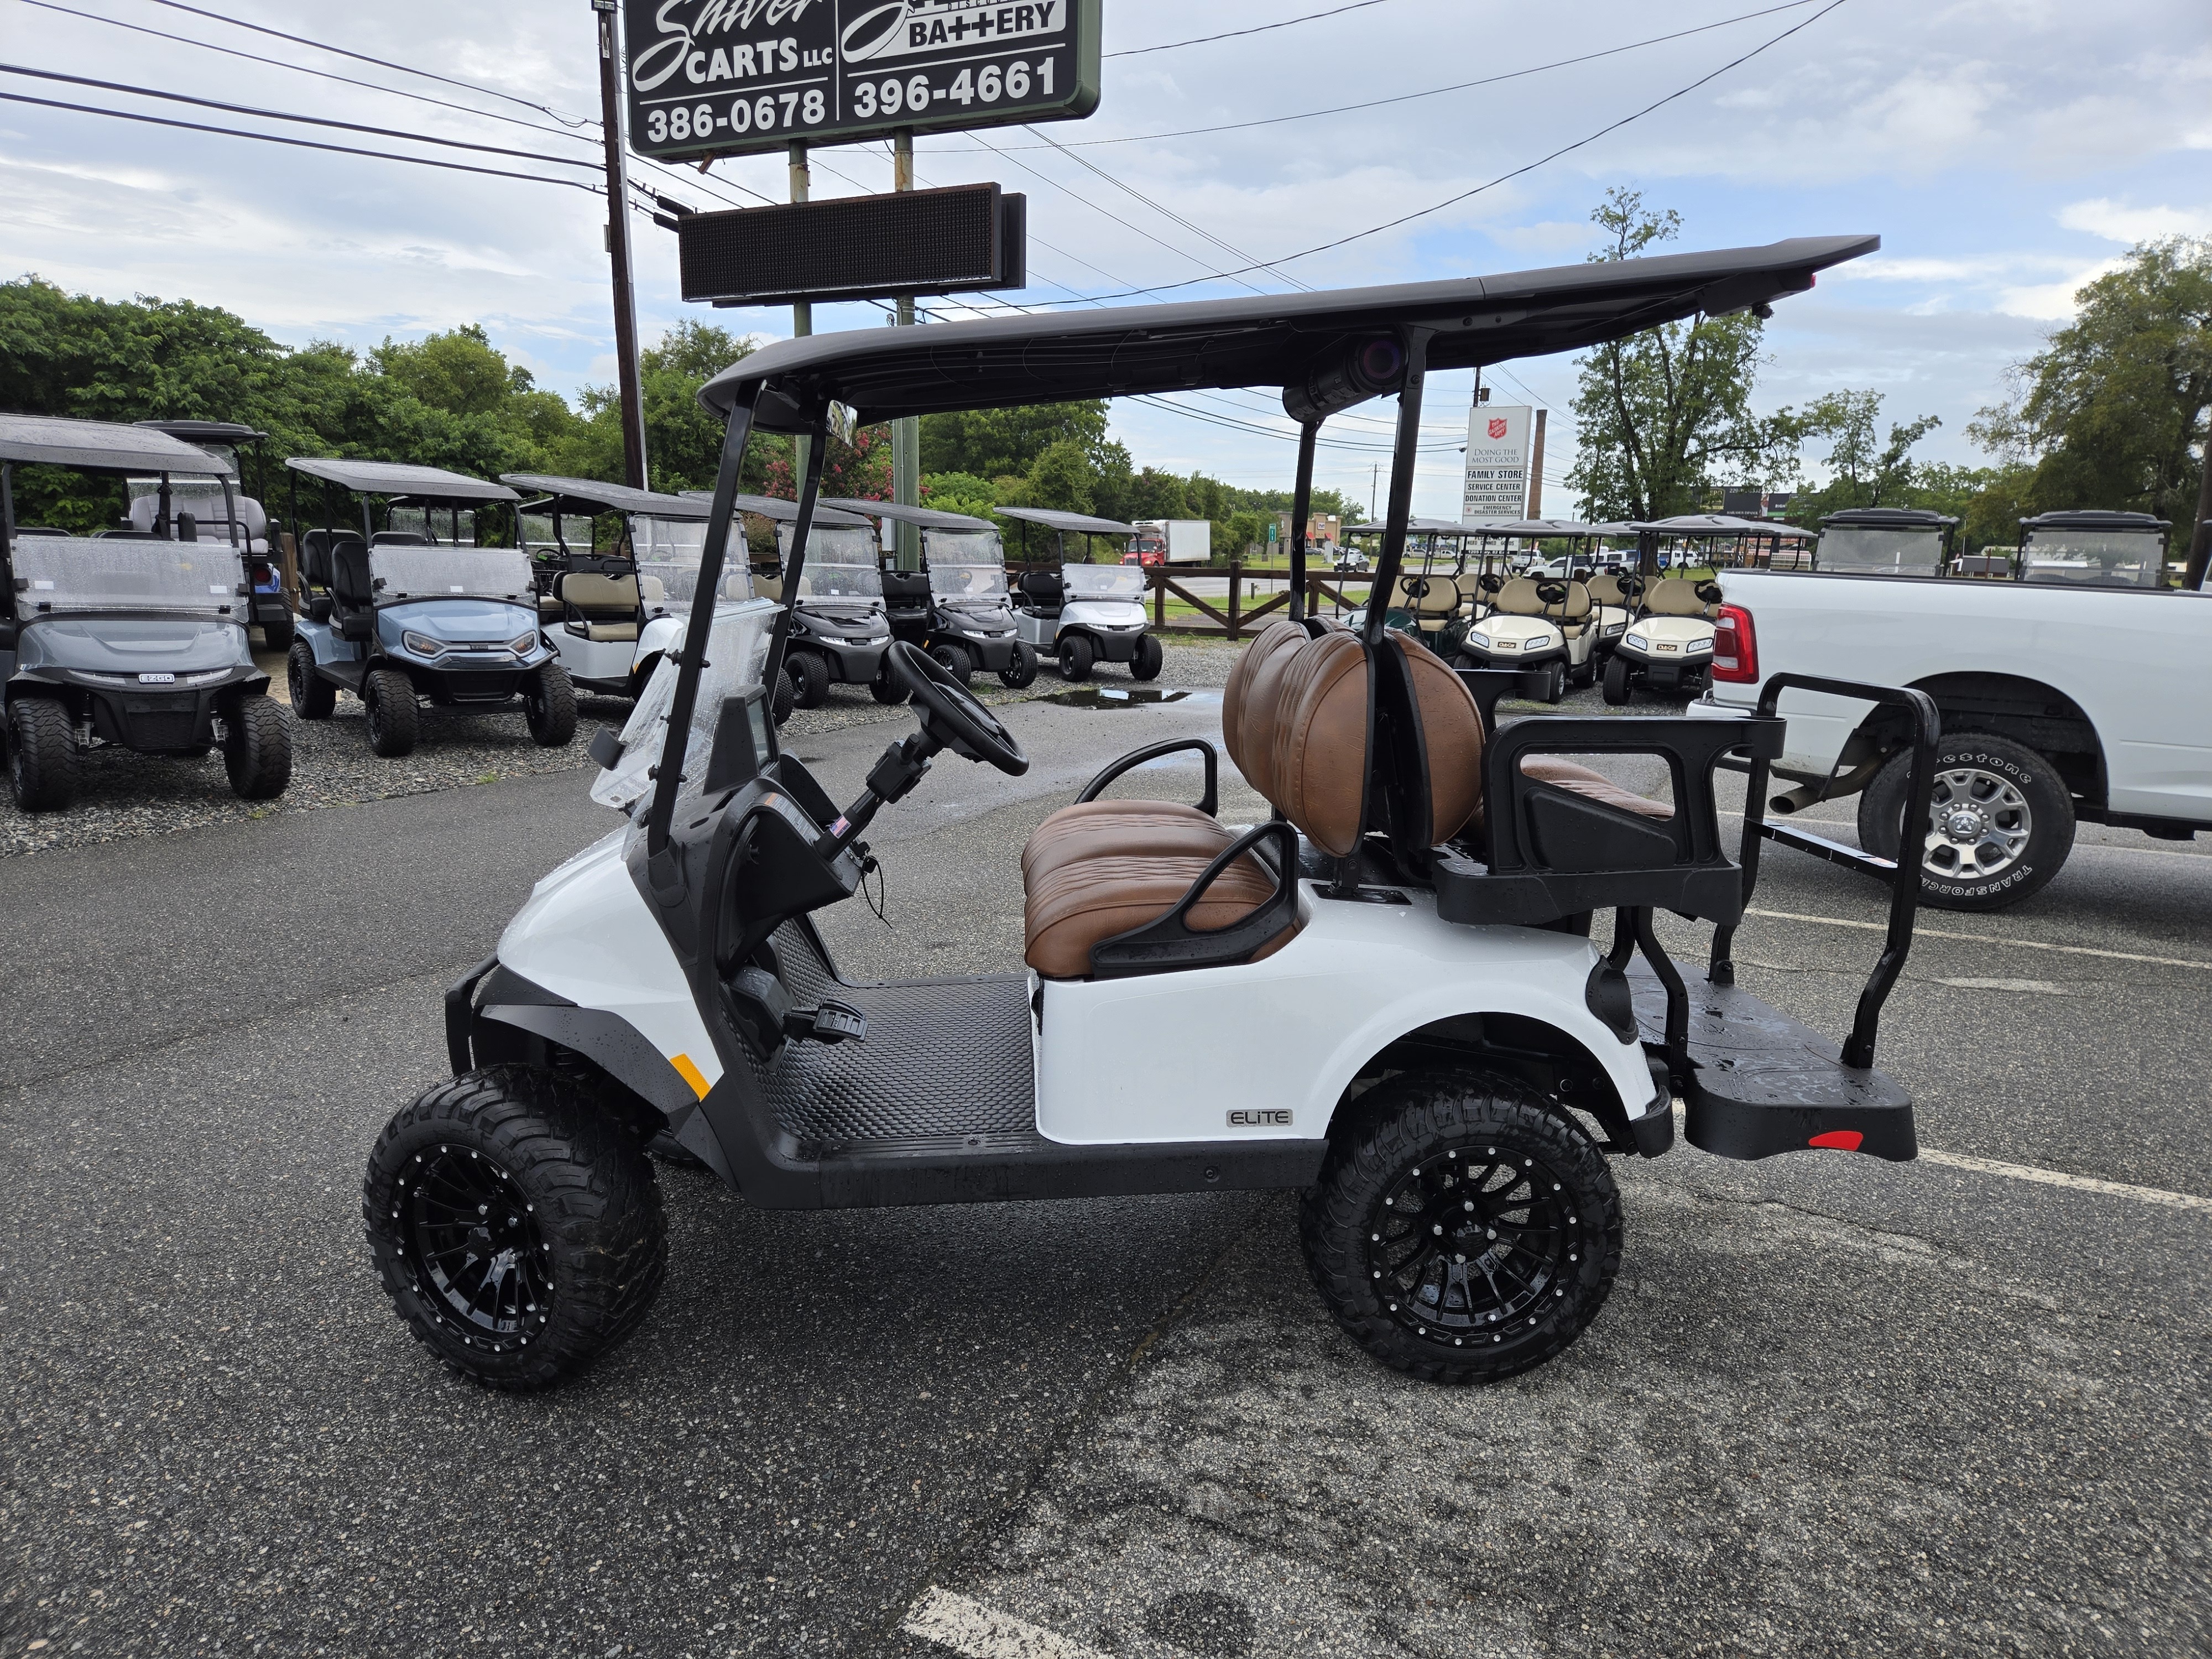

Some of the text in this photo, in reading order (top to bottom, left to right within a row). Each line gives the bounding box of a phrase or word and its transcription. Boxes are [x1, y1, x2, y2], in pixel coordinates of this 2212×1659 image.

[686, 37, 832, 84] CARTS LLC
[853, 56, 1055, 117] 396-4661
[647, 89, 826, 143] 386-0678
[1467, 470, 1522, 479] FAMILY STORE
